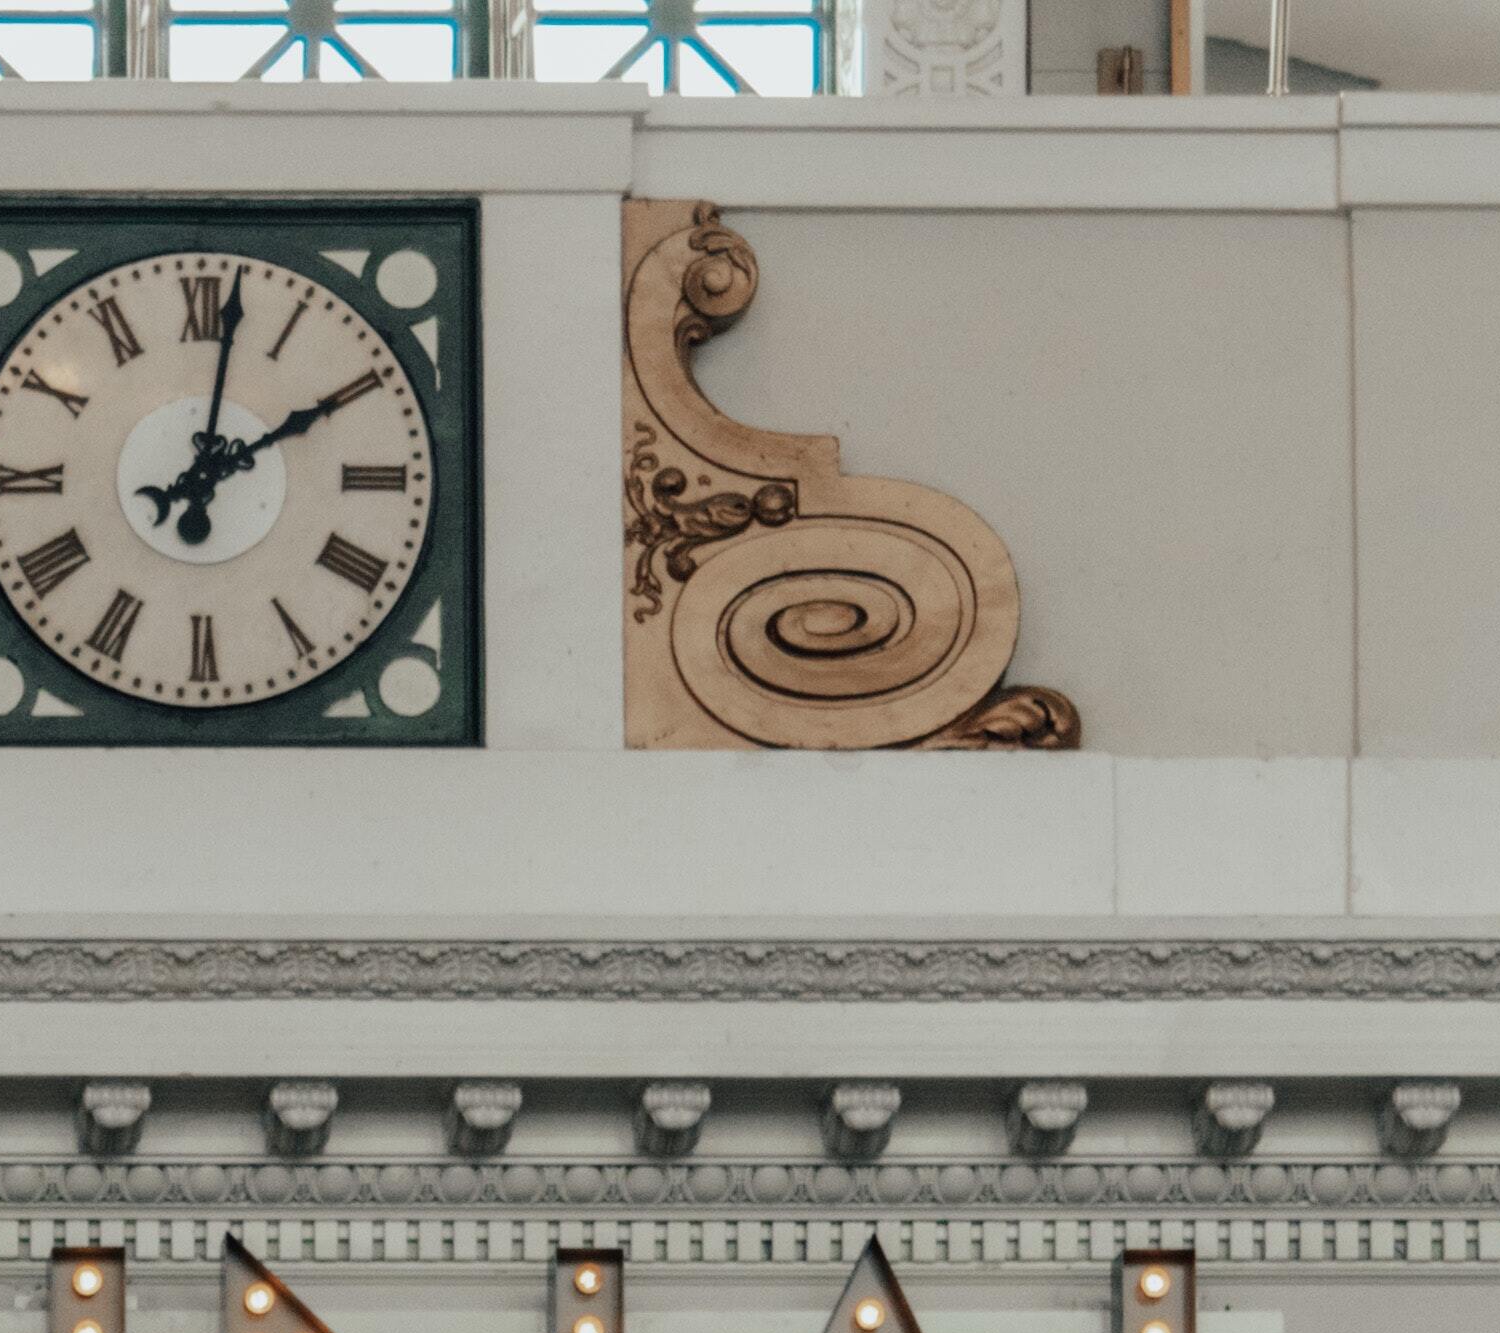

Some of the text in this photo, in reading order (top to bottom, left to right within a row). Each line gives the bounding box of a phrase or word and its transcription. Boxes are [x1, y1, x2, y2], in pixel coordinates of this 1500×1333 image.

[267, 301, 309, 361] I
[21, 368, 89, 418] X
[342, 463, 406, 491] III
[271, 597, 316, 658] V
